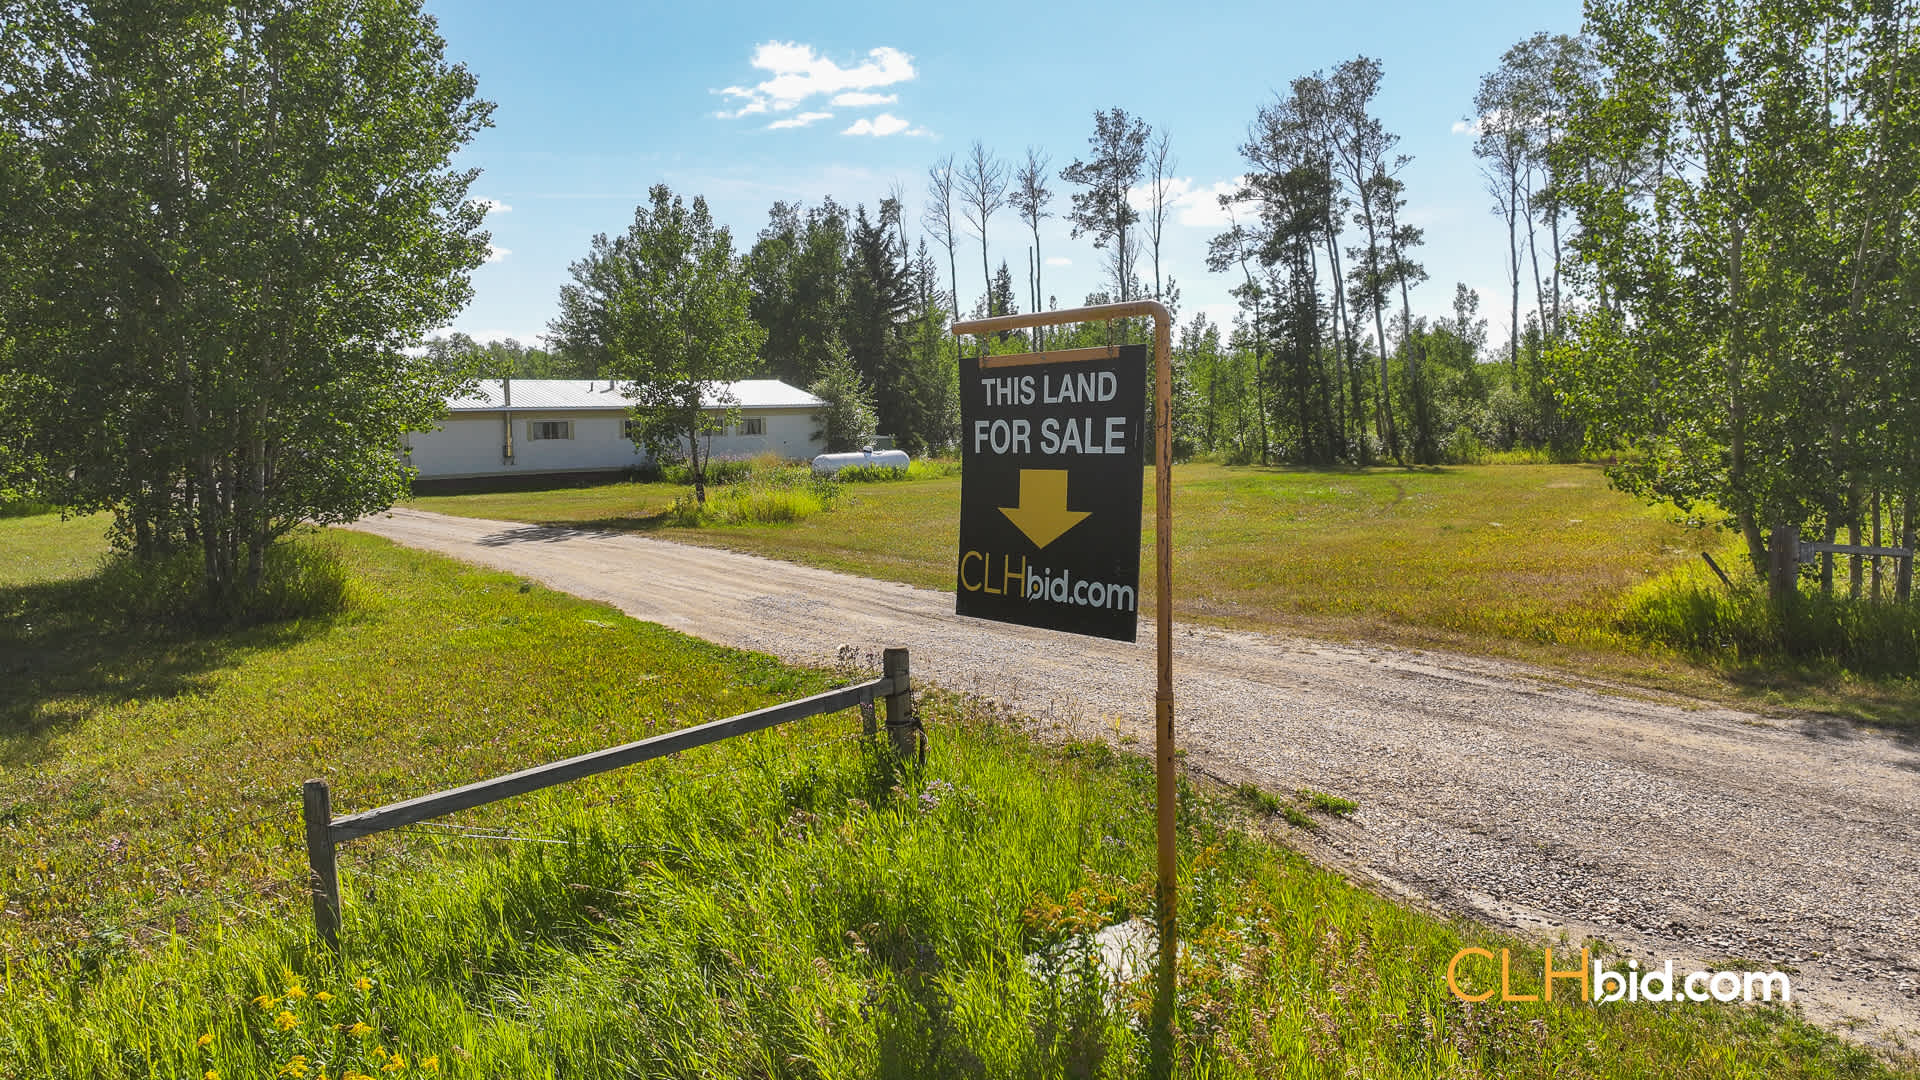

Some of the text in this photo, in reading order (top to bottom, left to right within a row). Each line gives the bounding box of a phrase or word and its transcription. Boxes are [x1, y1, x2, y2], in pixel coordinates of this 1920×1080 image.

[981, 371, 1118, 406] THIS LAND
[974, 416, 1126, 455] FOR SALE
[960, 550, 1135, 612] CLHbid.com
